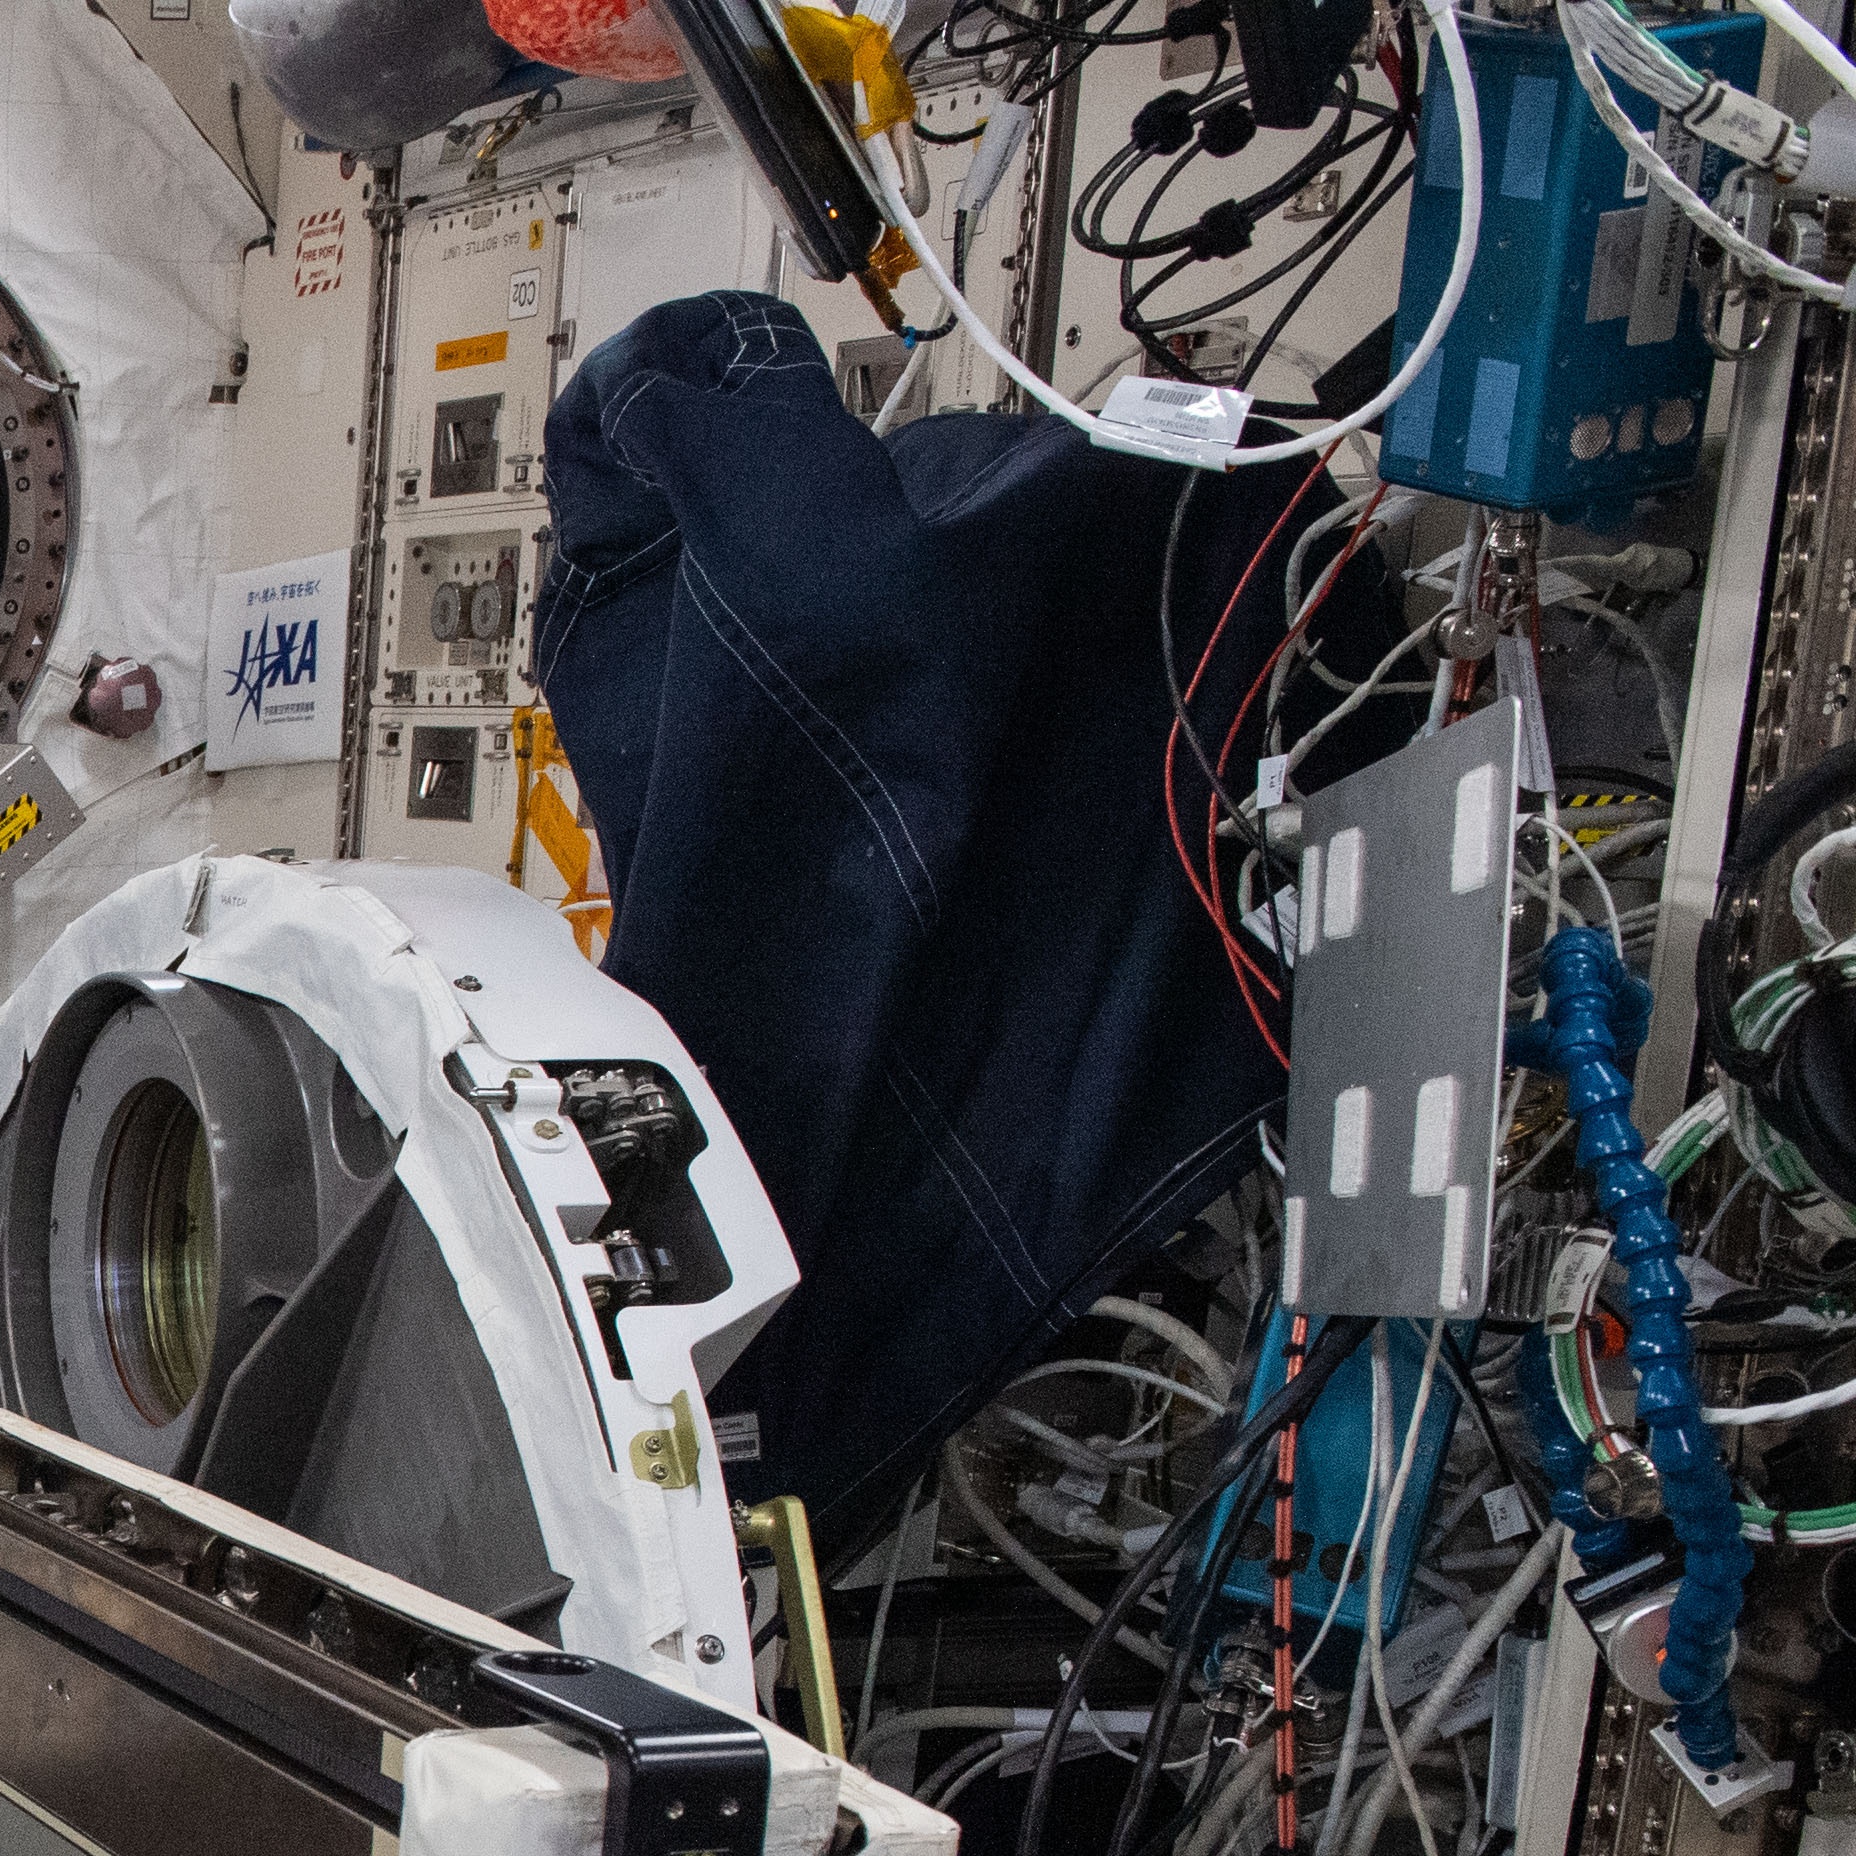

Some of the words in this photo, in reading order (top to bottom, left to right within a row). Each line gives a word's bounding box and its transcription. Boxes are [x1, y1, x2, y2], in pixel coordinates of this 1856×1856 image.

[465, 235, 498, 256] BOTTLE
[502, 230, 521, 245] GAS
[302, 249, 317, 262] FIRE
[319, 244, 337, 259] PORT
[224, 612, 318, 724] JAXA
